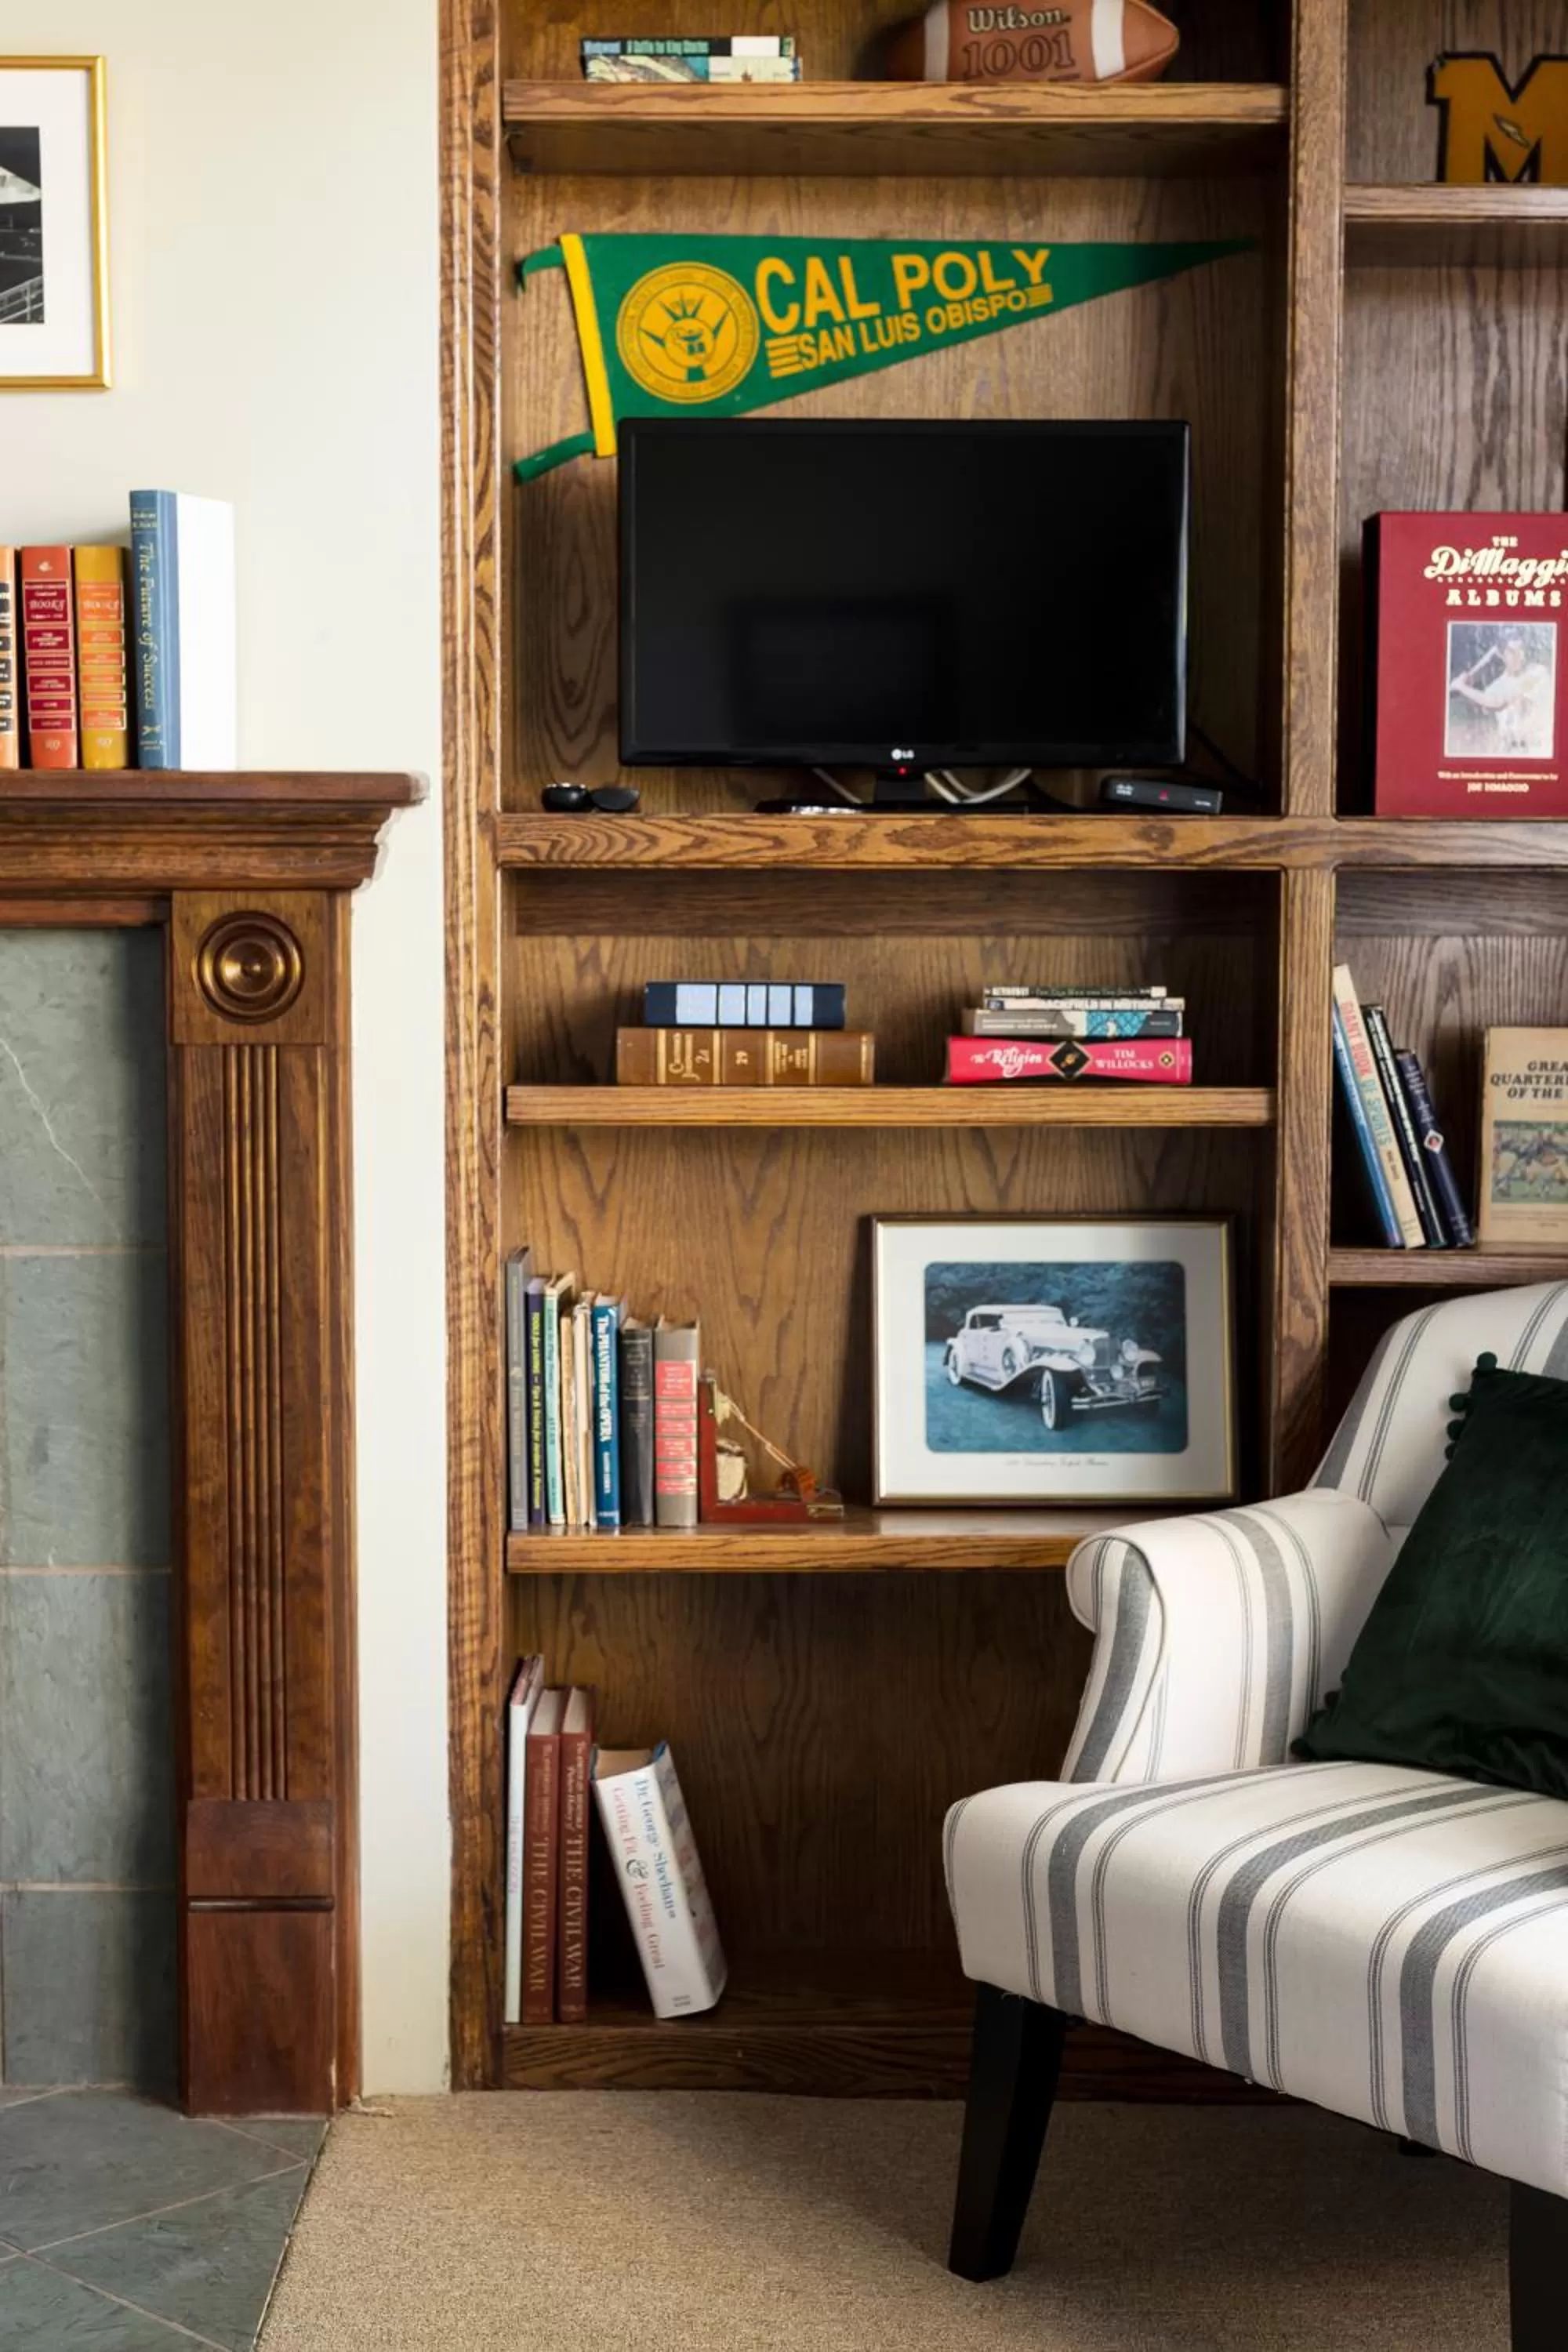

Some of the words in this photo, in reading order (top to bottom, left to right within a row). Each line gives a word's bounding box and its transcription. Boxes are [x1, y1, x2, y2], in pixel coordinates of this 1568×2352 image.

[967, 5, 1062, 34] Wilson
[963, 30, 1076, 81] 1001
[756, 256, 880, 334] CAL
[891, 249, 1051, 309] POLY
[797, 325, 855, 369] SAN
[859, 312, 921, 354] LUIS
[926, 290, 1026, 335] OBISPO
[139, 542, 154, 572] The
[1492, 535, 1519, 547] THE
[140, 576, 155, 627] Future
[1446, 589, 1562, 607] ALBUMS
[138, 631, 158, 651] of
[143, 652, 158, 710] Success
[1113, 1048, 1136, 1058] TIM
[1490, 1073, 1568, 1087] QUARTER
[1507, 1087, 1528, 1099] OF
[1531, 1087, 1563, 1099] THE
[597, 1316, 609, 1334] The
[597, 1334, 611, 1384] PHANTOM
[600, 1392, 610, 1407] the
[600, 1407, 612, 1442] OPERA
[531, 1836, 549, 1883] THE
[565, 1834, 583, 1882] THE
[626, 1858, 649, 1879] &
[530, 1888, 547, 1944] CIVIL
[564, 1886, 583, 1942] CIVIL
[529, 1945, 547, 1993] WAR
[564, 1943, 583, 1990] WAR
